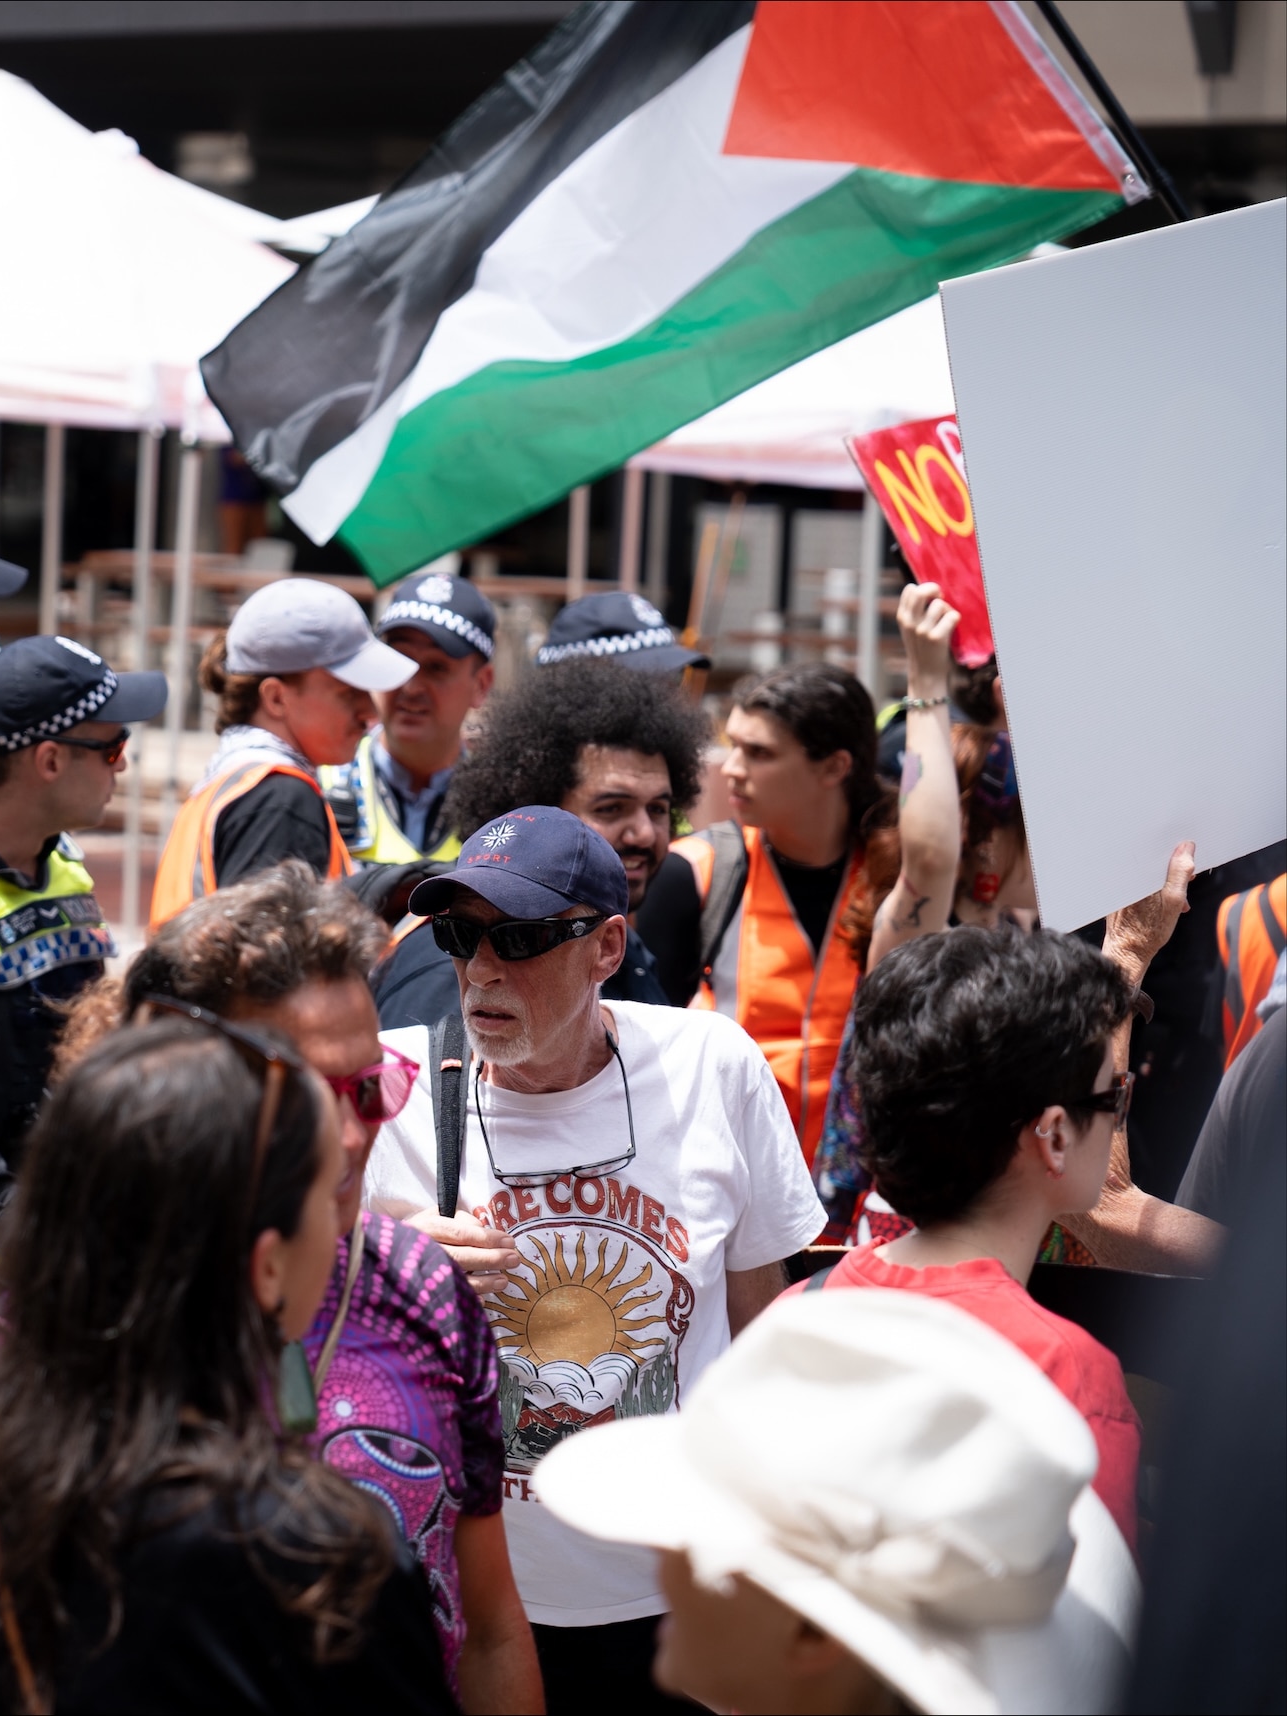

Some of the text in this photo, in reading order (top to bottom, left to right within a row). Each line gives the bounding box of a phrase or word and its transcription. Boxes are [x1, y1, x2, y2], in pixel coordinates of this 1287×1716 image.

[874, 443, 974, 546] NO
[467, 853, 511, 865] SPORT
[545, 1174, 690, 1264] COMES
